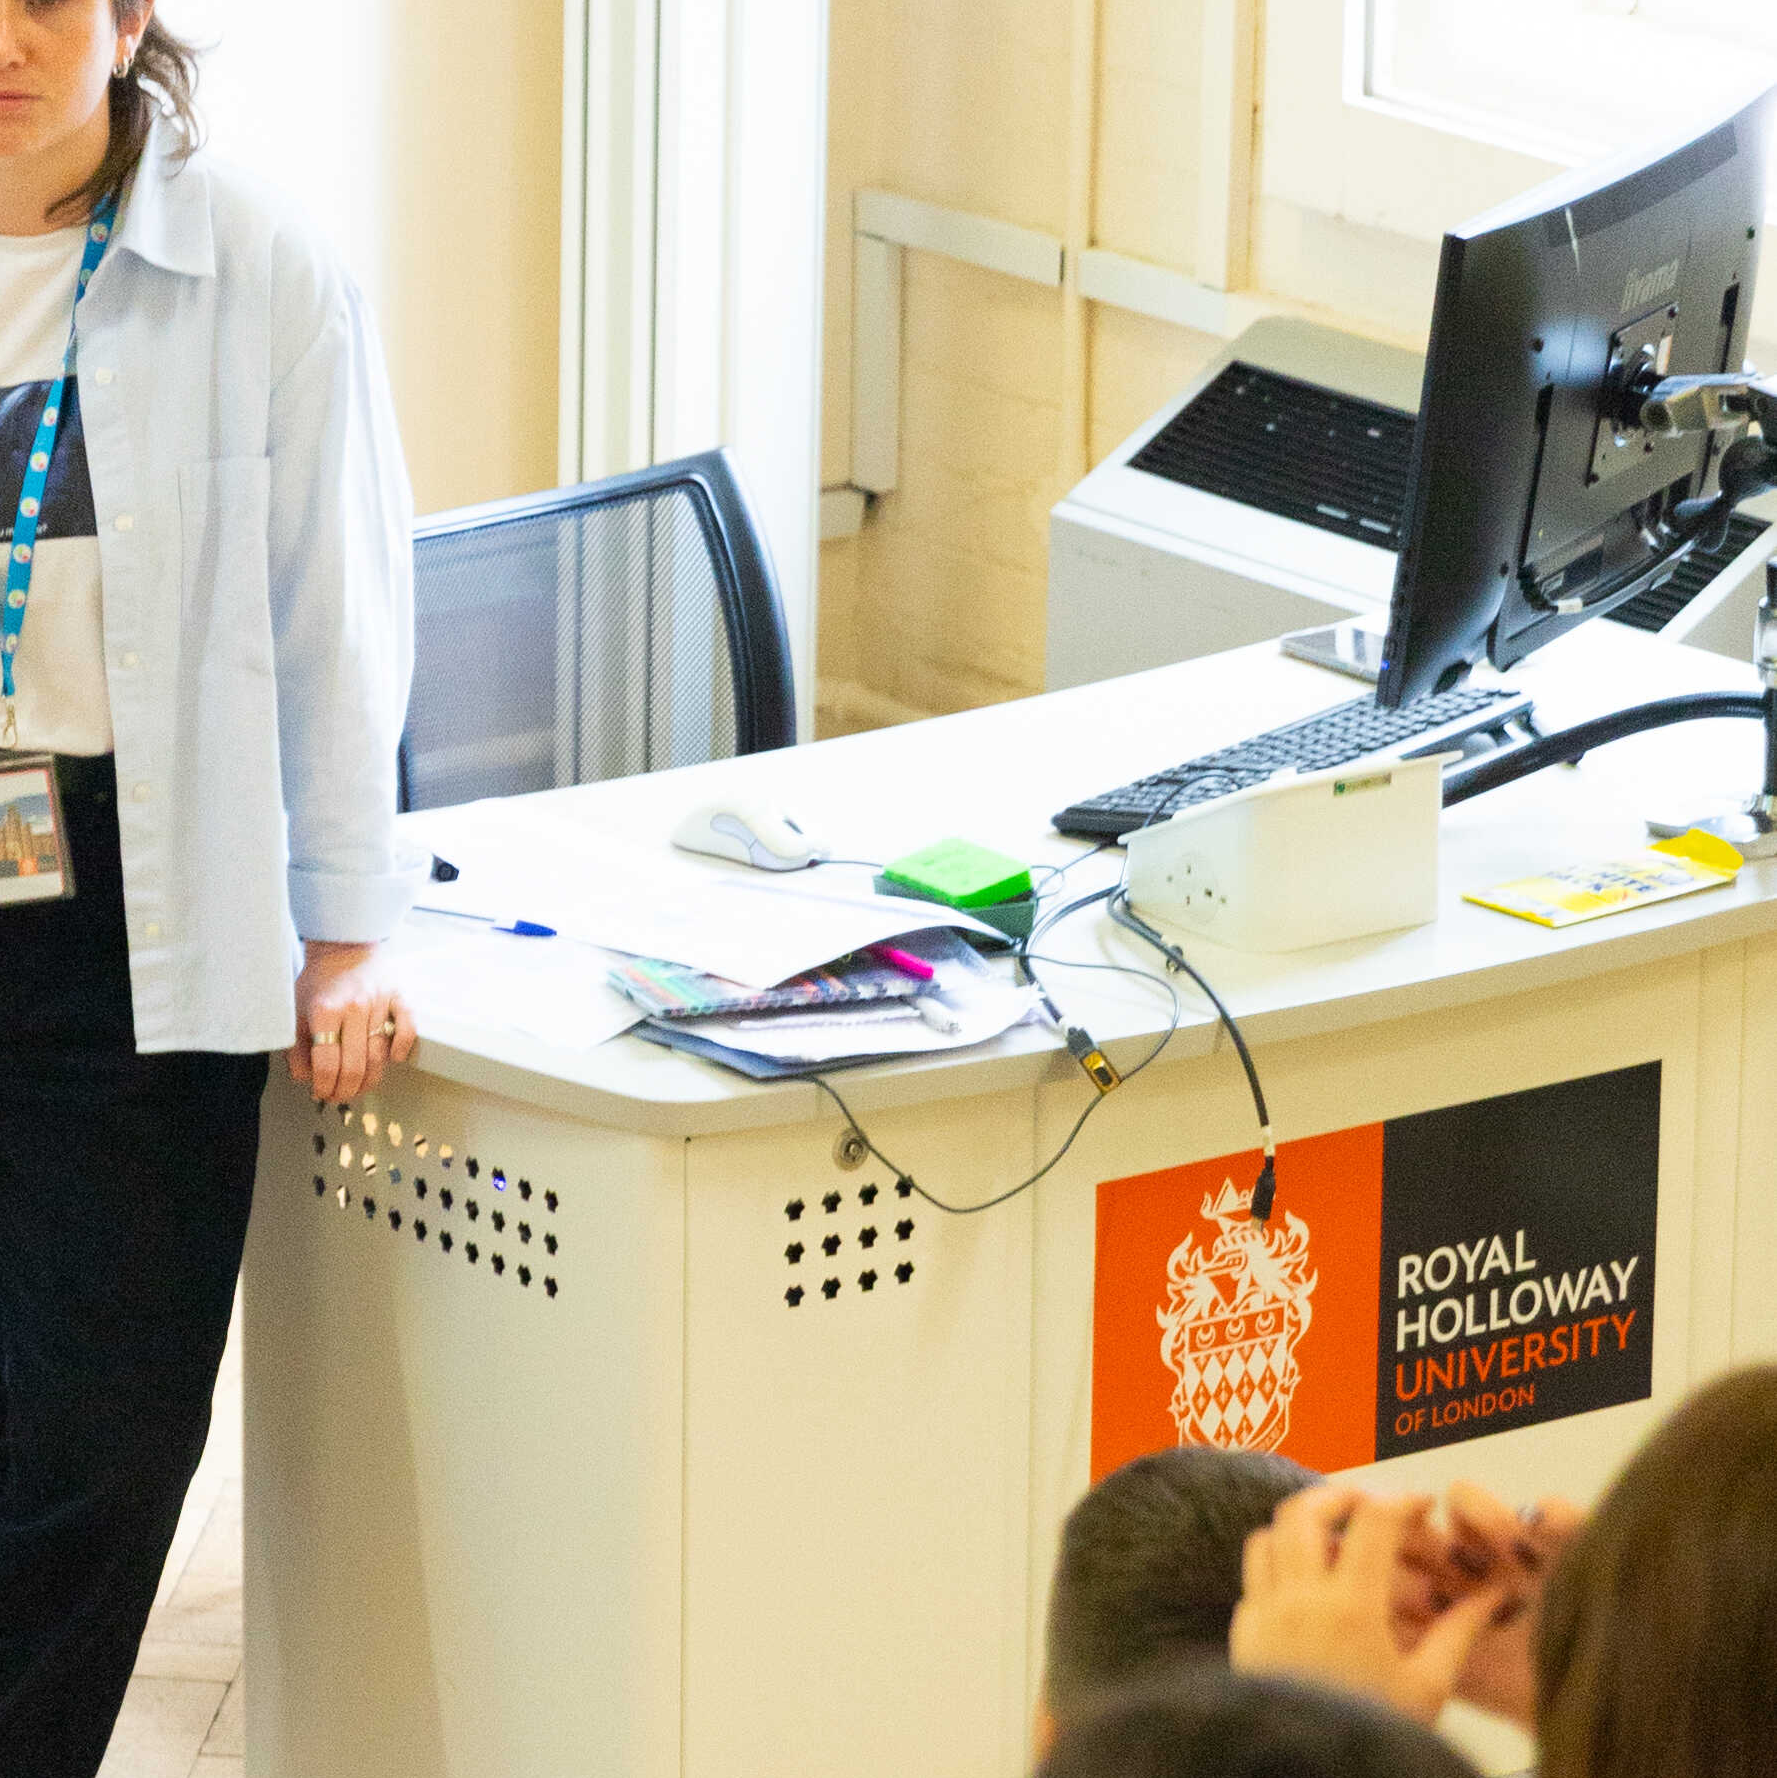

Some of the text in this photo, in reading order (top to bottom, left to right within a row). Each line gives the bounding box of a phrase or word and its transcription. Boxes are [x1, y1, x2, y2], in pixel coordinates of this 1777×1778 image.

[1396, 1255, 1639, 1353] HOLLOWAY
[1397, 1228, 1537, 1300] ROYAL
[1395, 1308, 1637, 1402] UNIVERSITY
[1394, 1383, 1535, 1437] OF LONDON
